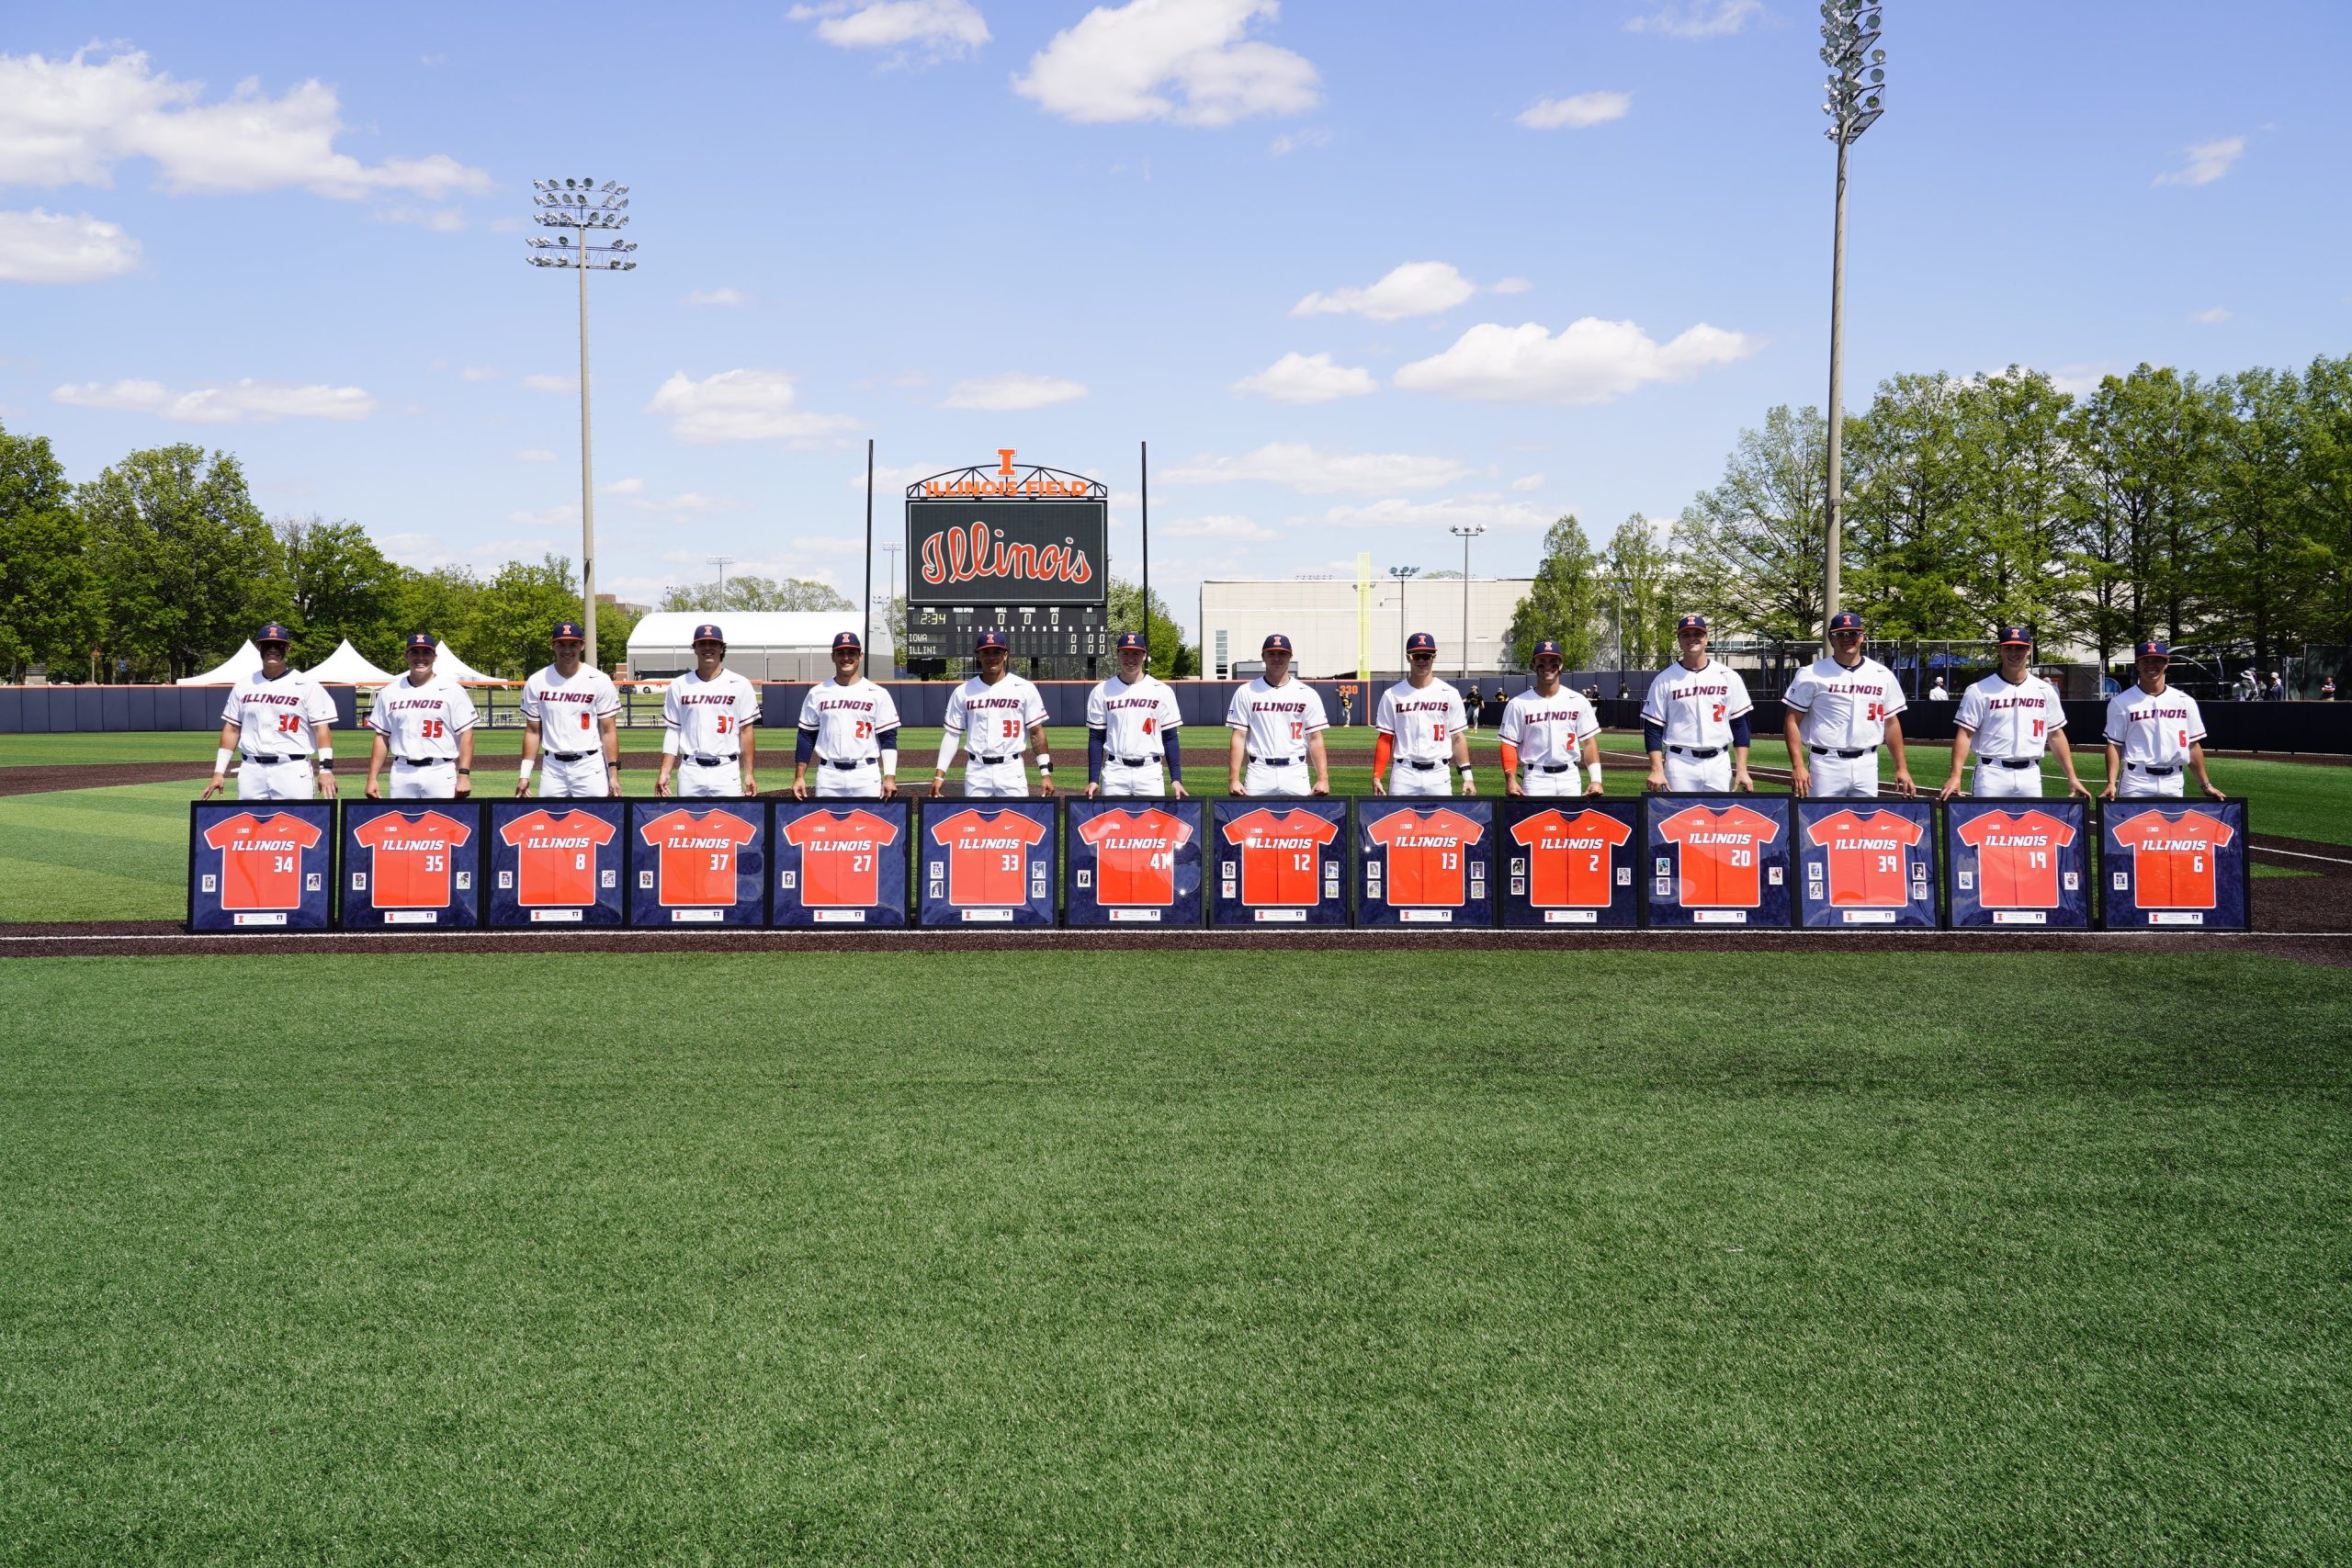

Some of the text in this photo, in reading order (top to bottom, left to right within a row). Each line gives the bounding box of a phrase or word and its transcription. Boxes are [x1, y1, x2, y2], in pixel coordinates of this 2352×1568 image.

[996, 448, 1017, 477] I
[926, 481, 1088, 496] ILLINOIS FIELD
[922, 521, 1091, 584] Illinois
[921, 614, 945, 625] 2:34
[998, 614, 1005, 625] 0
[1024, 614, 1031, 625] 0
[1051, 614, 1058, 625] 0
[1687, 616, 1696, 625] I
[1843, 615, 1851, 625] I
[268, 626, 277, 637] I
[562, 625, 571, 635] I
[704, 626, 712, 636] I
[2011, 628, 2019, 638] I
[416, 634, 424, 643] I
[842, 634, 851, 642] I
[910, 634, 927, 642] IOWA
[987, 634, 994, 643] I
[1127, 634, 1136, 644] I
[1273, 636, 1282, 646] I
[1419, 636, 1426, 645] I
[1544, 641, 1553, 650] I
[2148, 643, 2156, 652] I
[1340, 685, 1358, 694] 330
[1672, 685, 1727, 700] ILLINOIS
[1828, 684, 1883, 695] ILLINOIS
[243, 694, 300, 705] ILLINOIS
[540, 691, 594, 703] ILLINOIS
[682, 694, 735, 705] ILLINOIS
[390, 700, 443, 712] ILLINOIS
[820, 699, 873, 711] ILLINOIS
[967, 698, 1020, 710] ILLINOIS
[1106, 698, 1159, 711] ILLINOIS
[1252, 702, 1306, 713] ILLINOIS
[1396, 702, 1448, 713] ILLINOIS
[1990, 698, 2045, 710] ILLINOIS
[1525, 711, 1578, 724] ILLINOIS
[1867, 704, 1883, 721] 39
[2130, 708, 2187, 722] ILLINOIS
[278, 715, 300, 733] 34
[422, 720, 443, 738] 35
[717, 716, 734, 734] 37
[855, 721, 872, 739] 27
[1002, 720, 1020, 737] 33
[1142, 718, 1156, 735] 41
[2032, 719, 2044, 737] 19
[1290, 722, 1303, 739] 12
[1433, 724, 1445, 741] 13
[1566, 733, 1575, 750] 2
[2179, 730, 2187, 747] 6
[527, 837, 590, 849] ILLINOIS
[667, 837, 730, 849] ILLINOIS
[957, 839, 1020, 849] ILLINOIS
[1104, 838, 1167, 849] ILLINOIS
[1250, 839, 1313, 849] ILLINOIS
[1395, 837, 1458, 847] ILLINOIS
[1541, 839, 1603, 849] ILLINOIS
[1689, 833, 1752, 844] ILLINOIS
[1985, 836, 2048, 847] ILLINOIS
[232, 840, 296, 852] ILLINOIS
[382, 840, 445, 851] ILLINOIS
[809, 840, 871, 851] ILLINOIS
[1836, 839, 1897, 851] ILLINOIS
[2142, 840, 2207, 851] ILLINOIS
[274, 856, 293, 873] 34
[425, 855, 443, 872] 35
[575, 854, 585, 870] 8
[710, 854, 728, 871] 37
[854, 855, 871, 872] 27
[1001, 854, 1018, 871] 33
[1150, 853, 1167, 870] 41
[1294, 854, 1310, 871] 12
[1442, 853, 1457, 869] 13
[1589, 855, 1599, 871] 2
[1731, 850, 1750, 867] 20
[1878, 856, 1896, 873] 39
[2030, 852, 2046, 869] 19
[2194, 856, 2202, 873] 6
